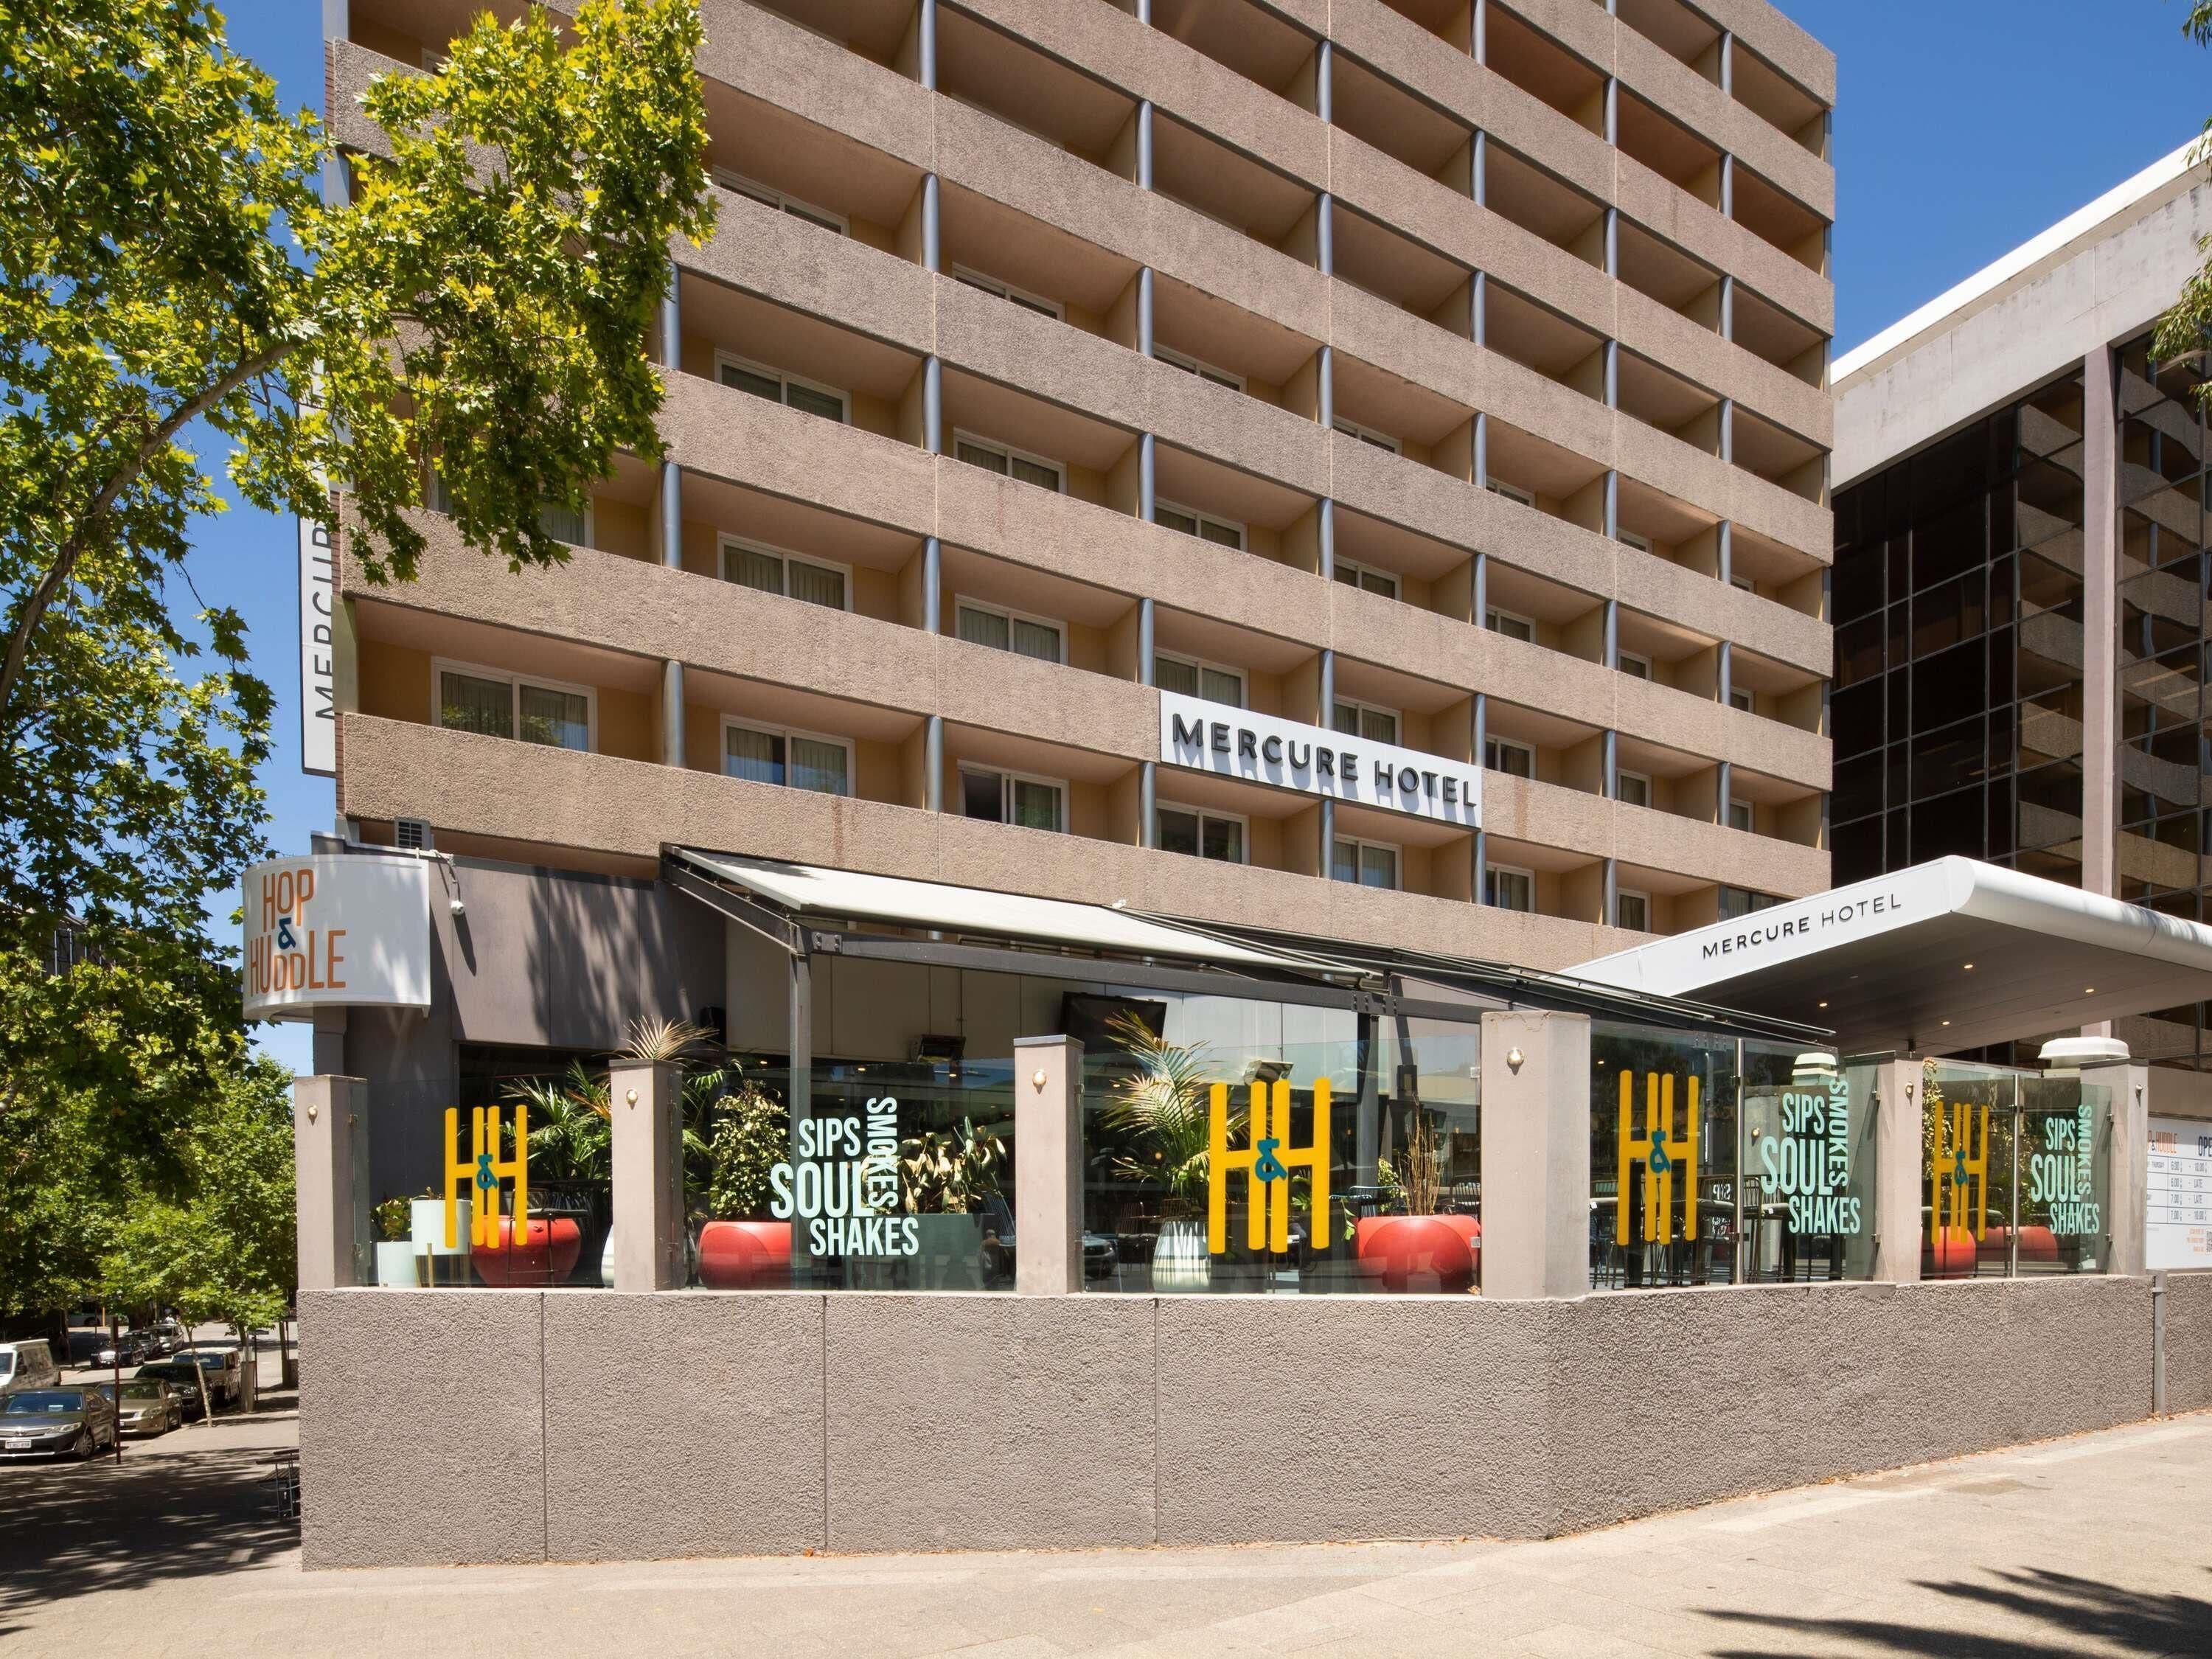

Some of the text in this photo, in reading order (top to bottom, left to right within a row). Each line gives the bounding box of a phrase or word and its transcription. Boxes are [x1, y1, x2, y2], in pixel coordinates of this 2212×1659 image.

[312, 527, 335, 720] MERCUR
[1172, 713, 1477, 807] MERCURE HOTEL
[263, 869, 314, 933] HOP
[1702, 893, 1902, 960] MERCURE HOTEL
[277, 917, 296, 950] &
[251, 930, 347, 997] HUDDLE
[799, 1117, 861, 1158] SIPS
[1782, 1092, 1826, 1135] SIPS
[1829, 1079, 1850, 1187] SMOKES
[2045, 1116, 2076, 1152] SIPS
[866, 1096, 899, 1208] SMOKES
[1761, 1135, 1834, 1195] SOUL
[2077, 1105, 2093, 1195] SMOKES
[2198, 1135, 2212, 1158] OPE
[771, 1161, 875, 1220] SOUL
[2030, 1153, 2081, 1203] SOUL
[810, 1217, 919, 1256] SHAKES
[1788, 1194, 1861, 1234] SHAKES
[2049, 1203, 2101, 1235] SHAKES
